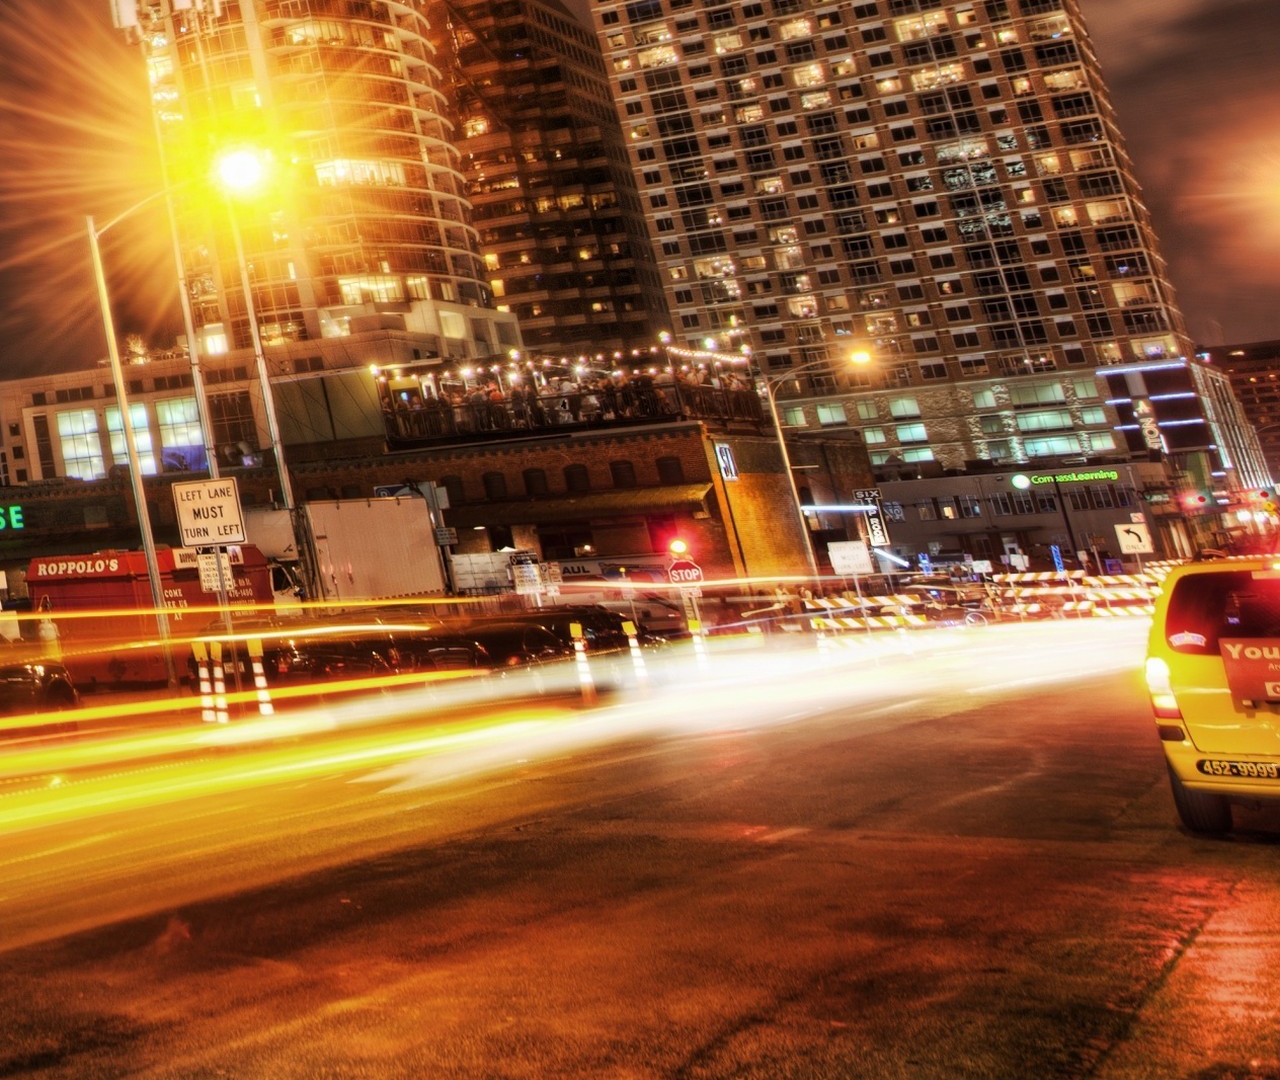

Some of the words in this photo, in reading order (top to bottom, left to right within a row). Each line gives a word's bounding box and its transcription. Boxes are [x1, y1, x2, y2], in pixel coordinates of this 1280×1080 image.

[1030, 471, 1118, 484] ComassLearning
[180, 490, 202, 501] LEFT
[208, 487, 232, 499] LANE
[855, 490, 879, 499] SIX
[192, 506, 224, 520] MUST
[864, 498, 877, 516] TP
[184, 527, 209, 539] TURN
[217, 524, 240, 536] LEFT
[37, 559, 119, 576] ROPPOLO'S
[562, 565, 590, 575] AUL
[671, 568, 700, 581] STOP
[164, 589, 183, 598] COME
